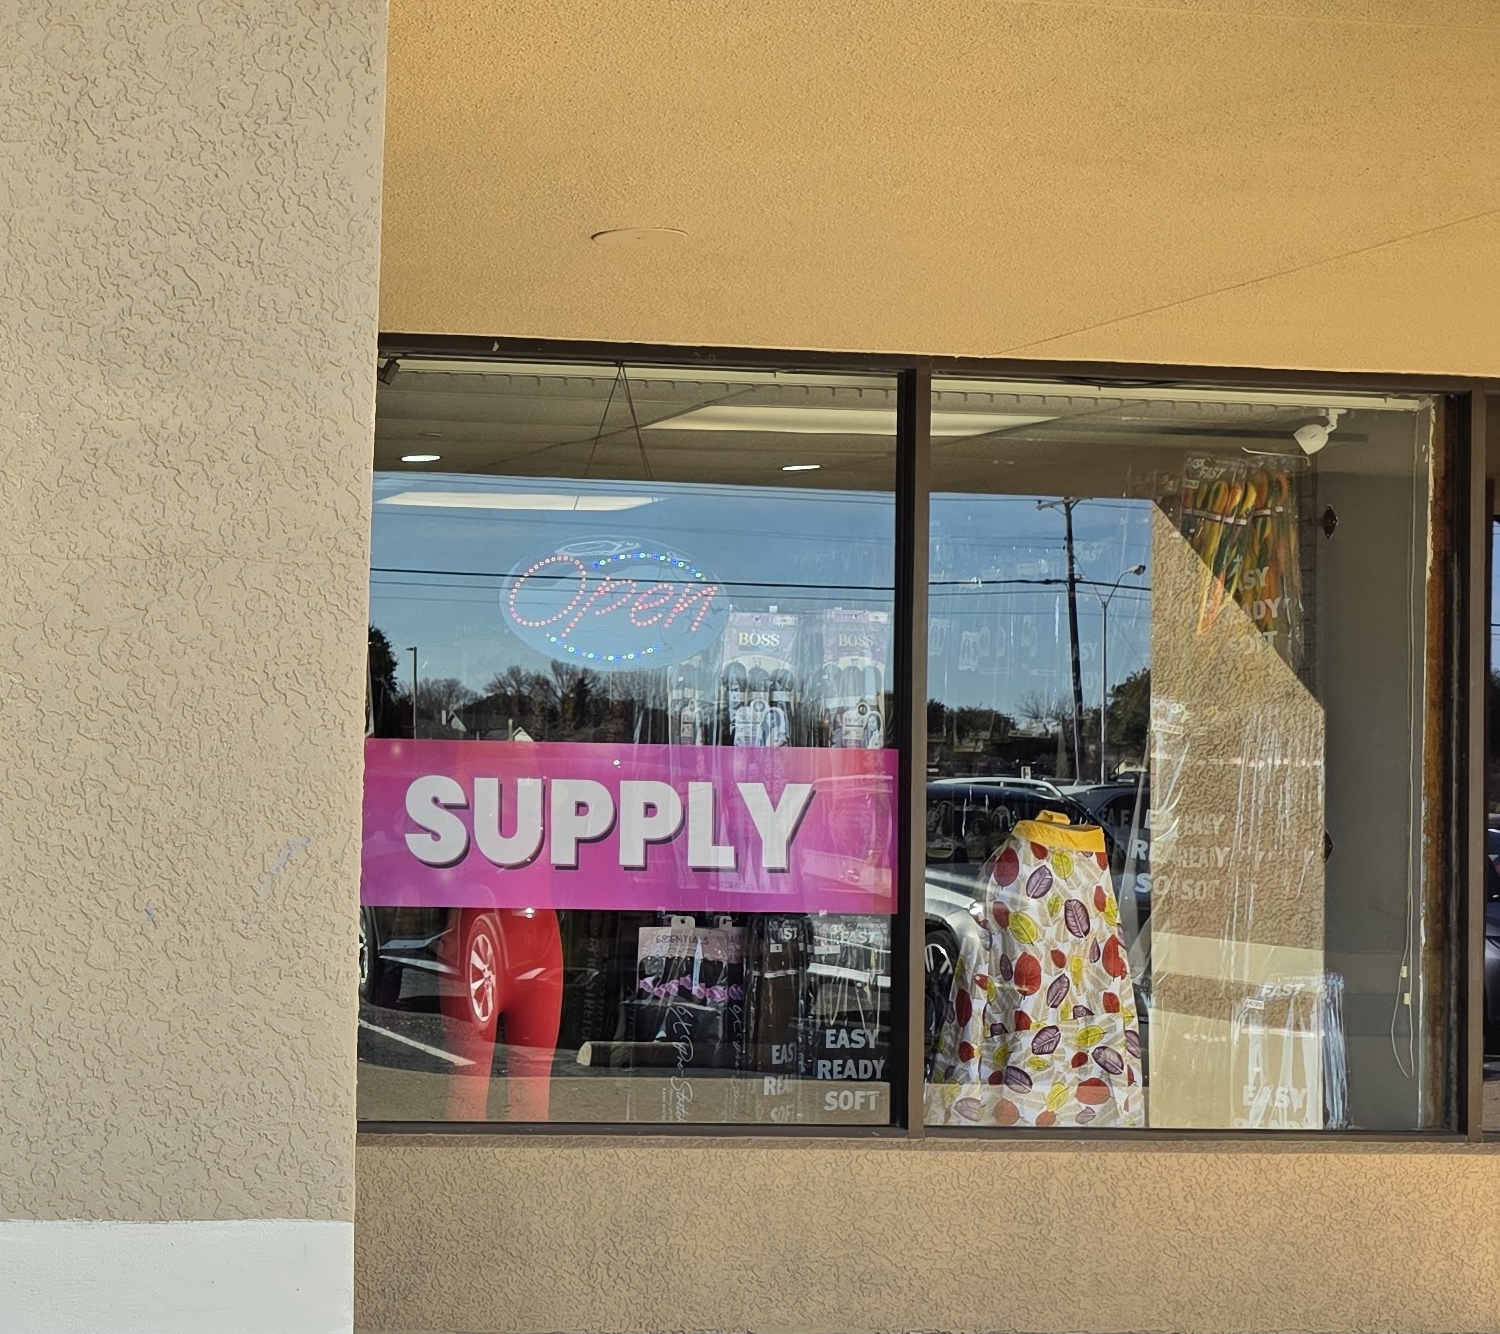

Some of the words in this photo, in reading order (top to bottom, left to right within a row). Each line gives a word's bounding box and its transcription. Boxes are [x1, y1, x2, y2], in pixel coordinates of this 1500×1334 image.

[509, 555, 718, 637] Open
[738, 632, 780, 646] BOSS
[838, 633, 874, 647] BOSS
[404, 775, 815, 870] SUPPLY
[1261, 983, 1305, 998] FAST
[825, 1028, 879, 1049] EASY
[771, 1042, 797, 1065] EAS
[817, 1059, 886, 1080] READY
[823, 1090, 880, 1111] SOFT
[1243, 1084, 1308, 1109] EASY
